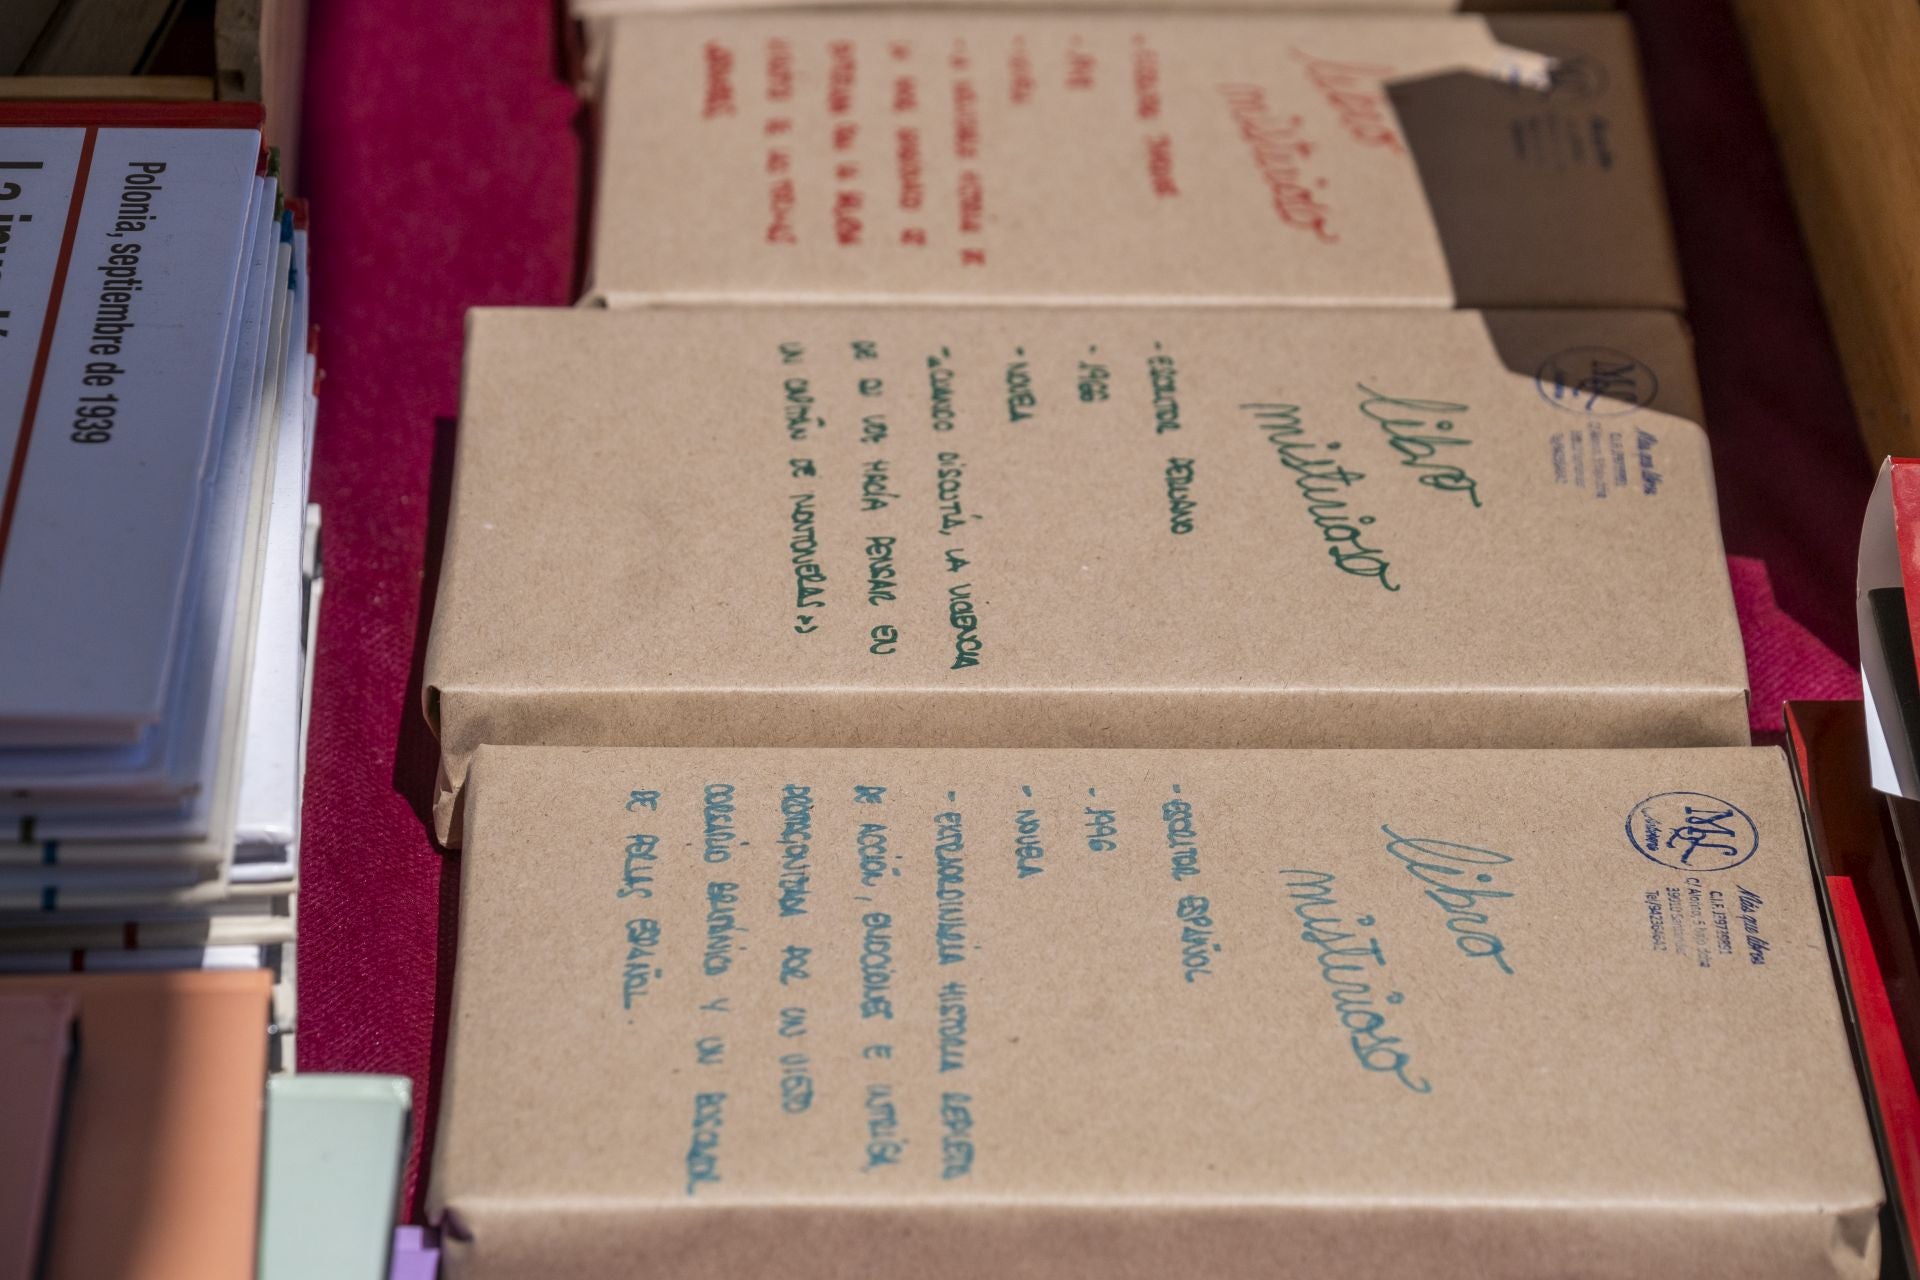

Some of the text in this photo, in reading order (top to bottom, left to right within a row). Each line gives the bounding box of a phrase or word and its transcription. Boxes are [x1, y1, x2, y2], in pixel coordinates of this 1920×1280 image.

[71, 162, 166, 443] Polonia, septiembre de 1939
[1006, 363, 1036, 422] NOVELA
[789, 459, 816, 477] DE
[1353, 384, 1482, 508] libro
[1165, 457, 1197, 534] PERUANO
[1242, 401, 1405, 592] misterioso
[866, 537, 897, 606] PENSAR
[945, 549, 970, 572] LA
[870, 625, 898, 654] EN
[949, 584, 982, 669] VIOLENCIA
[625, 791, 660, 812] DE
[703, 784, 750, 863] CORSARIO
[854, 785, 886, 804] DE
[1085, 807, 1117, 851] 1996
[617, 834, 659, 898] PERLAS
[1015, 810, 1044, 878] NOVELA
[1162, 799, 1200, 881] ESCRITOR
[703, 882, 748, 976] BRITÁNICO
[1377, 824, 1514, 975] libro
[1736, 885, 1770, 964] Más que libros
[776, 784, 814, 1113] PROTAGONIZADA POR UN VIEJO
[860, 912, 895, 1020] EMOCIONES
[1176, 895, 1221, 983] ESPAÑOL
[699, 998, 729, 1012] Y
[1279, 867, 1437, 1093] misterioso
[696, 1037, 724, 1065] UN
[863, 1044, 892, 1059] E
[938, 982, 967, 1073] HISTORIA
